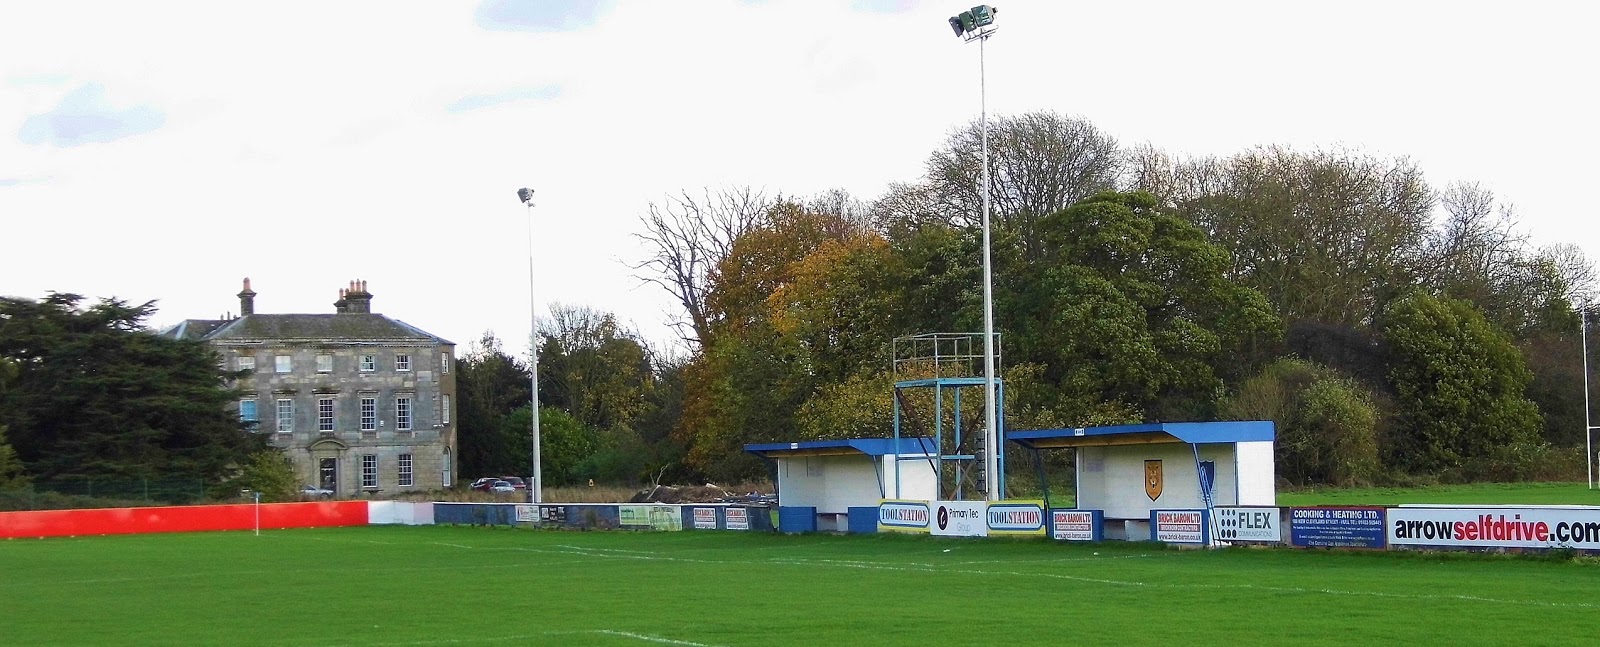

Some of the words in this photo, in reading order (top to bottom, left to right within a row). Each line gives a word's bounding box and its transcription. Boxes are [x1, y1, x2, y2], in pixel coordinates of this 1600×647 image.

[881, 508, 927, 521] TOOLSTATION
[949, 508, 969, 520] Primary
[969, 509, 979, 519] Tec
[988, 510, 1040, 524] TOOLSTATION
[1055, 513, 1067, 523] BRICK
[1067, 513, 1082, 523] BARON
[1082, 514, 1091, 523] LTD
[1158, 513, 1173, 523] BRICK
[1173, 513, 1190, 523] BARON
[1190, 513, 1201, 524] LTD
[1294, 510, 1324, 519] COOKING
[1325, 510, 1331, 519] &
[1332, 510, 1362, 519] HEATING
[1363, 510, 1379, 519] LTD.
[1238, 512, 1272, 529] FLEX
[957, 522, 971, 534] Group
[1238, 530, 1273, 538] COMMUNICATIONS
[1395, 514, 1600, 542] arrowselfdrive.com
